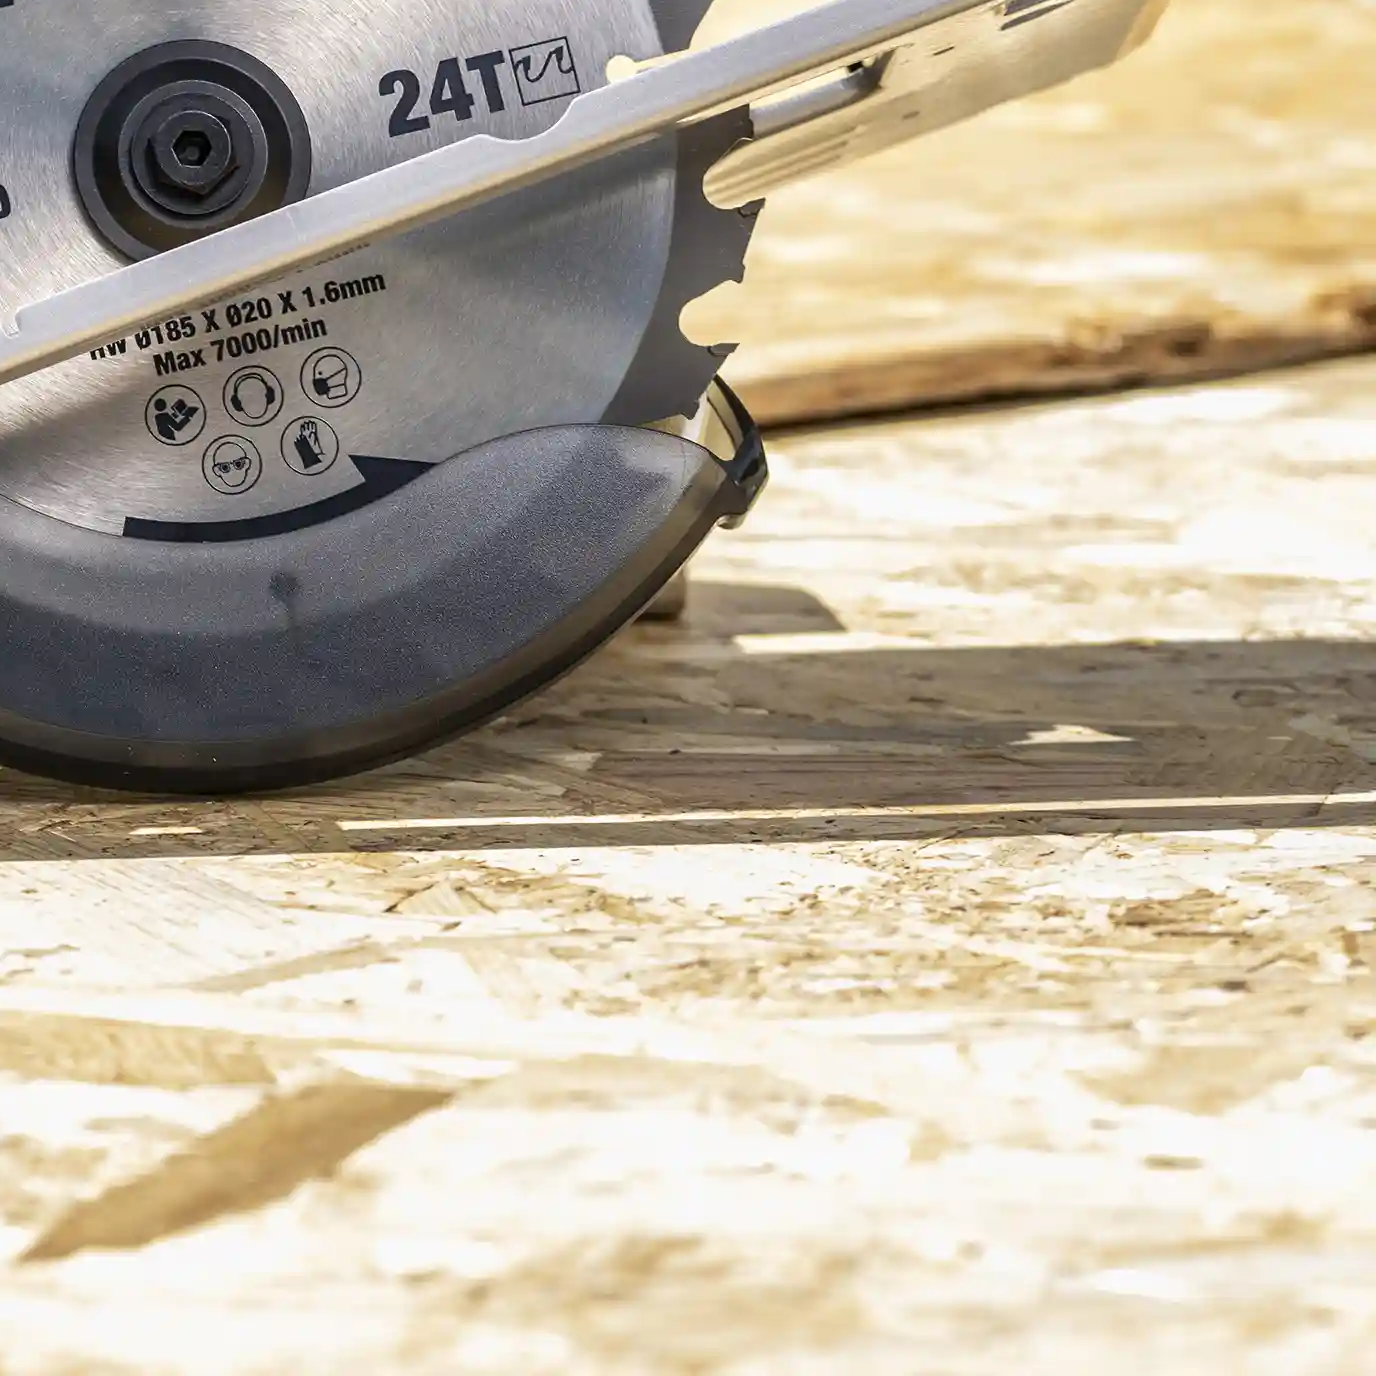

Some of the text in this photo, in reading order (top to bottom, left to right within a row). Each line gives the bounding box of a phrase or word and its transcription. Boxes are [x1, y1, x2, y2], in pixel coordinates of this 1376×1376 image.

[378, 50, 506, 138] 24T
[301, 273, 387, 308] 1.6mm
[152, 316, 329, 377] Max 7000/min
